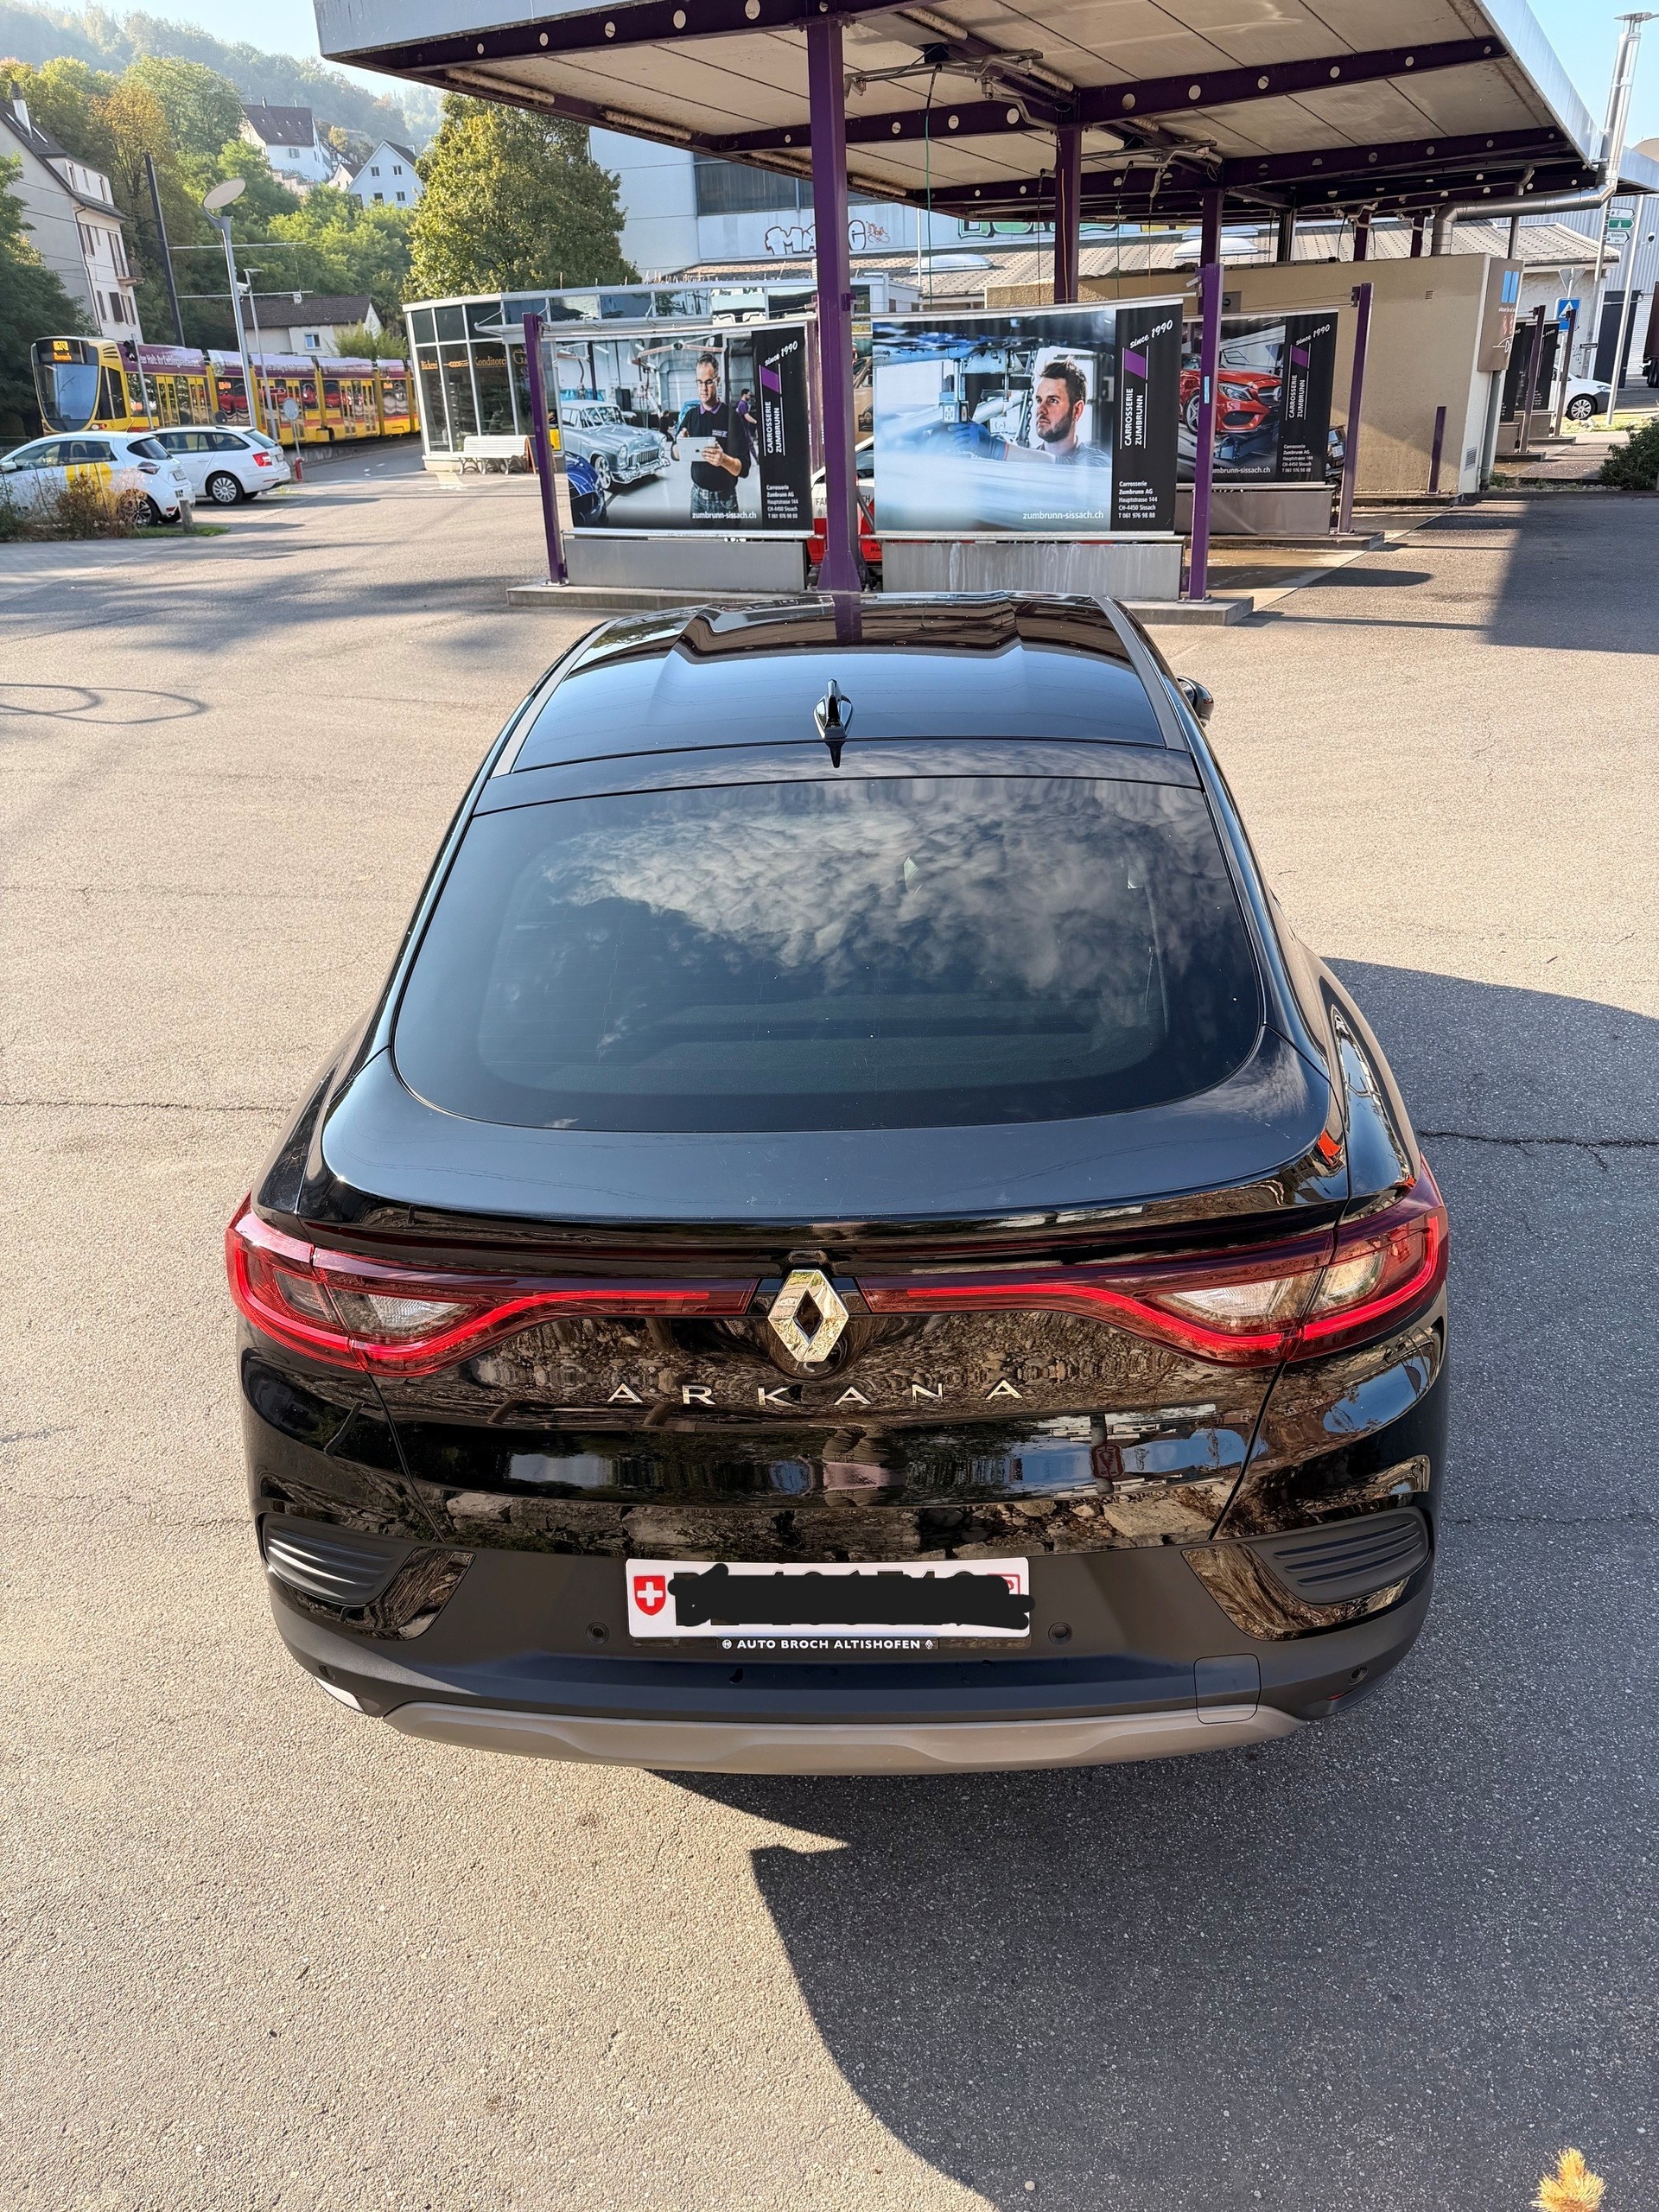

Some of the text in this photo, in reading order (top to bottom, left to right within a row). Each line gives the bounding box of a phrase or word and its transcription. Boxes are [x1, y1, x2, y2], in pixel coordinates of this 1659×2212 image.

[1129, 319, 1173, 349] since 1990
[1296, 323, 1331, 346] since 1990
[765, 340, 798, 366] since 1990
[1288, 374, 1297, 418] CARROSSERIE
[1297, 379, 1306, 418] ZUMBRUNN
[765, 401, 773, 454] CARROSSERIE
[1124, 388, 1134, 446] CARROSSERIE
[1135, 395, 1144, 446] ZUMBRUNN
[692, 511, 757, 519] zumbrunn-sissach.ch
[1022, 511, 1103, 519] zumbrunn-sissach.ch
[607, 1378, 1024, 1406] ARKANA
[736, 1639, 920, 1649] AUTO BROCH ALTISHOFEN
